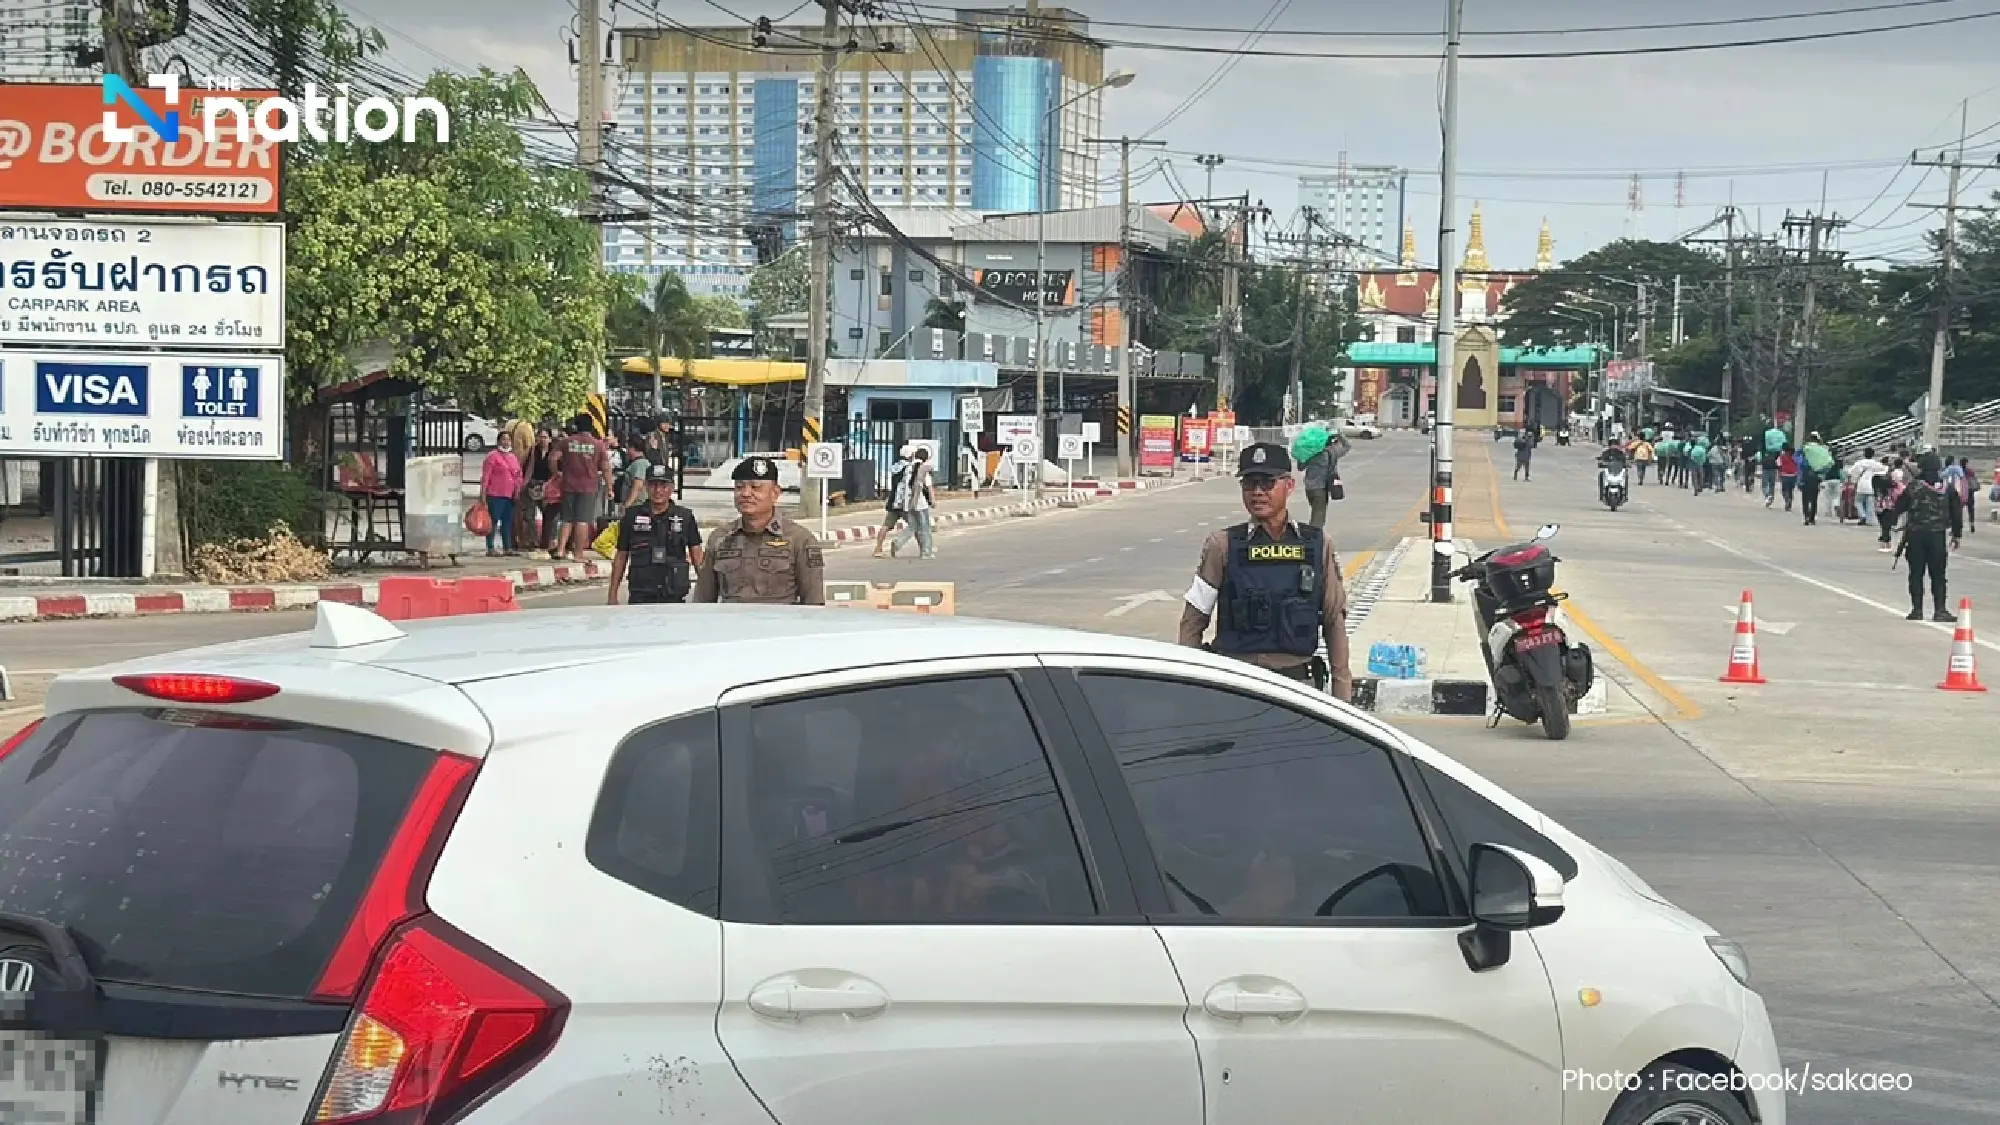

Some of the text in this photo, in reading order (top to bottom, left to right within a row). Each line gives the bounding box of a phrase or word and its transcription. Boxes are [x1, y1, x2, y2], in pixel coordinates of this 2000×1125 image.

[38, 122, 274, 169] BORDER
[103, 180, 258, 198] Tel. 080-5542121
[137, 230, 152, 243] 2
[0, 248, 268, 294] รรับฝากรถ
[8, 297, 141, 313] CARPARK AREA
[189, 325, 206, 335] 24
[46, 374, 138, 405] VISA
[195, 402, 247, 415] TOLET
[1251, 546, 1302, 559] POLICE
